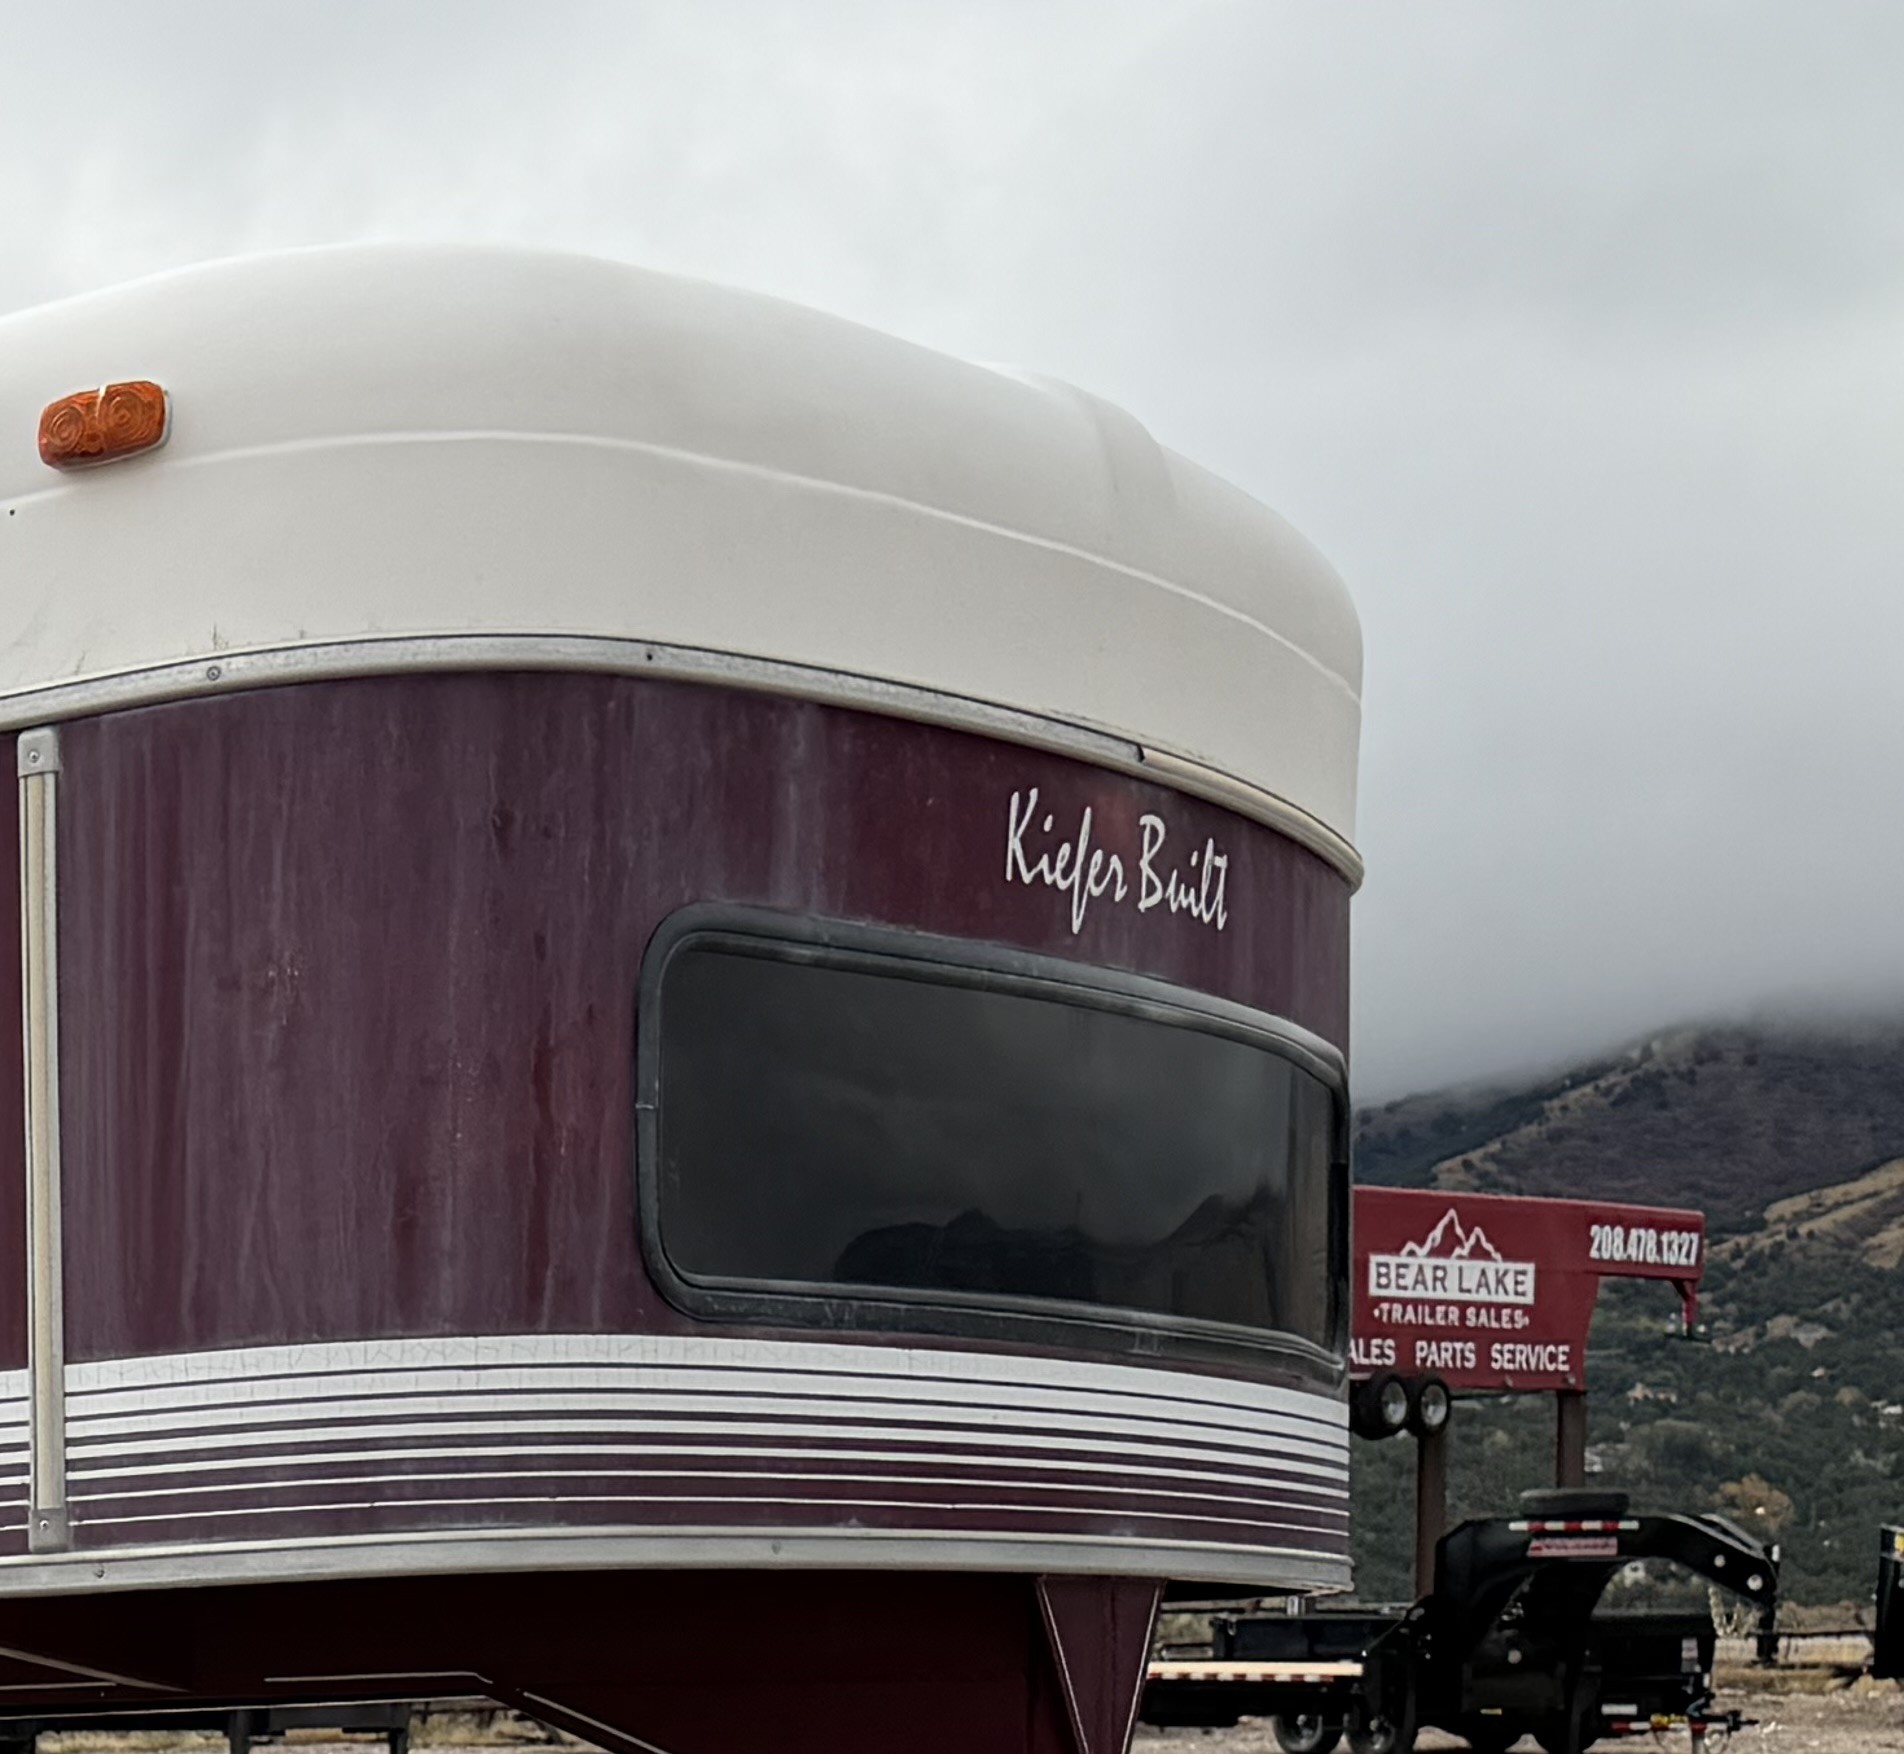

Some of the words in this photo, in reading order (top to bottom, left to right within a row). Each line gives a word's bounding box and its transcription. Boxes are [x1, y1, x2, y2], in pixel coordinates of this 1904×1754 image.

[1005, 786, 1128, 935] Kiefer
[1137, 814, 1229, 931] Built
[1589, 1224, 1700, 1267] 208.478.1327
[1374, 1261, 1448, 1293] BEAR
[1457, 1265, 1529, 1297] LAKE
[1379, 1302, 1460, 1327] TRAILER
[1465, 1305, 1524, 1330] SALES
[1349, 1337, 1396, 1366] ALES
[1414, 1340, 1477, 1369] PARTS
[1490, 1342, 1571, 1372] SERVICE
